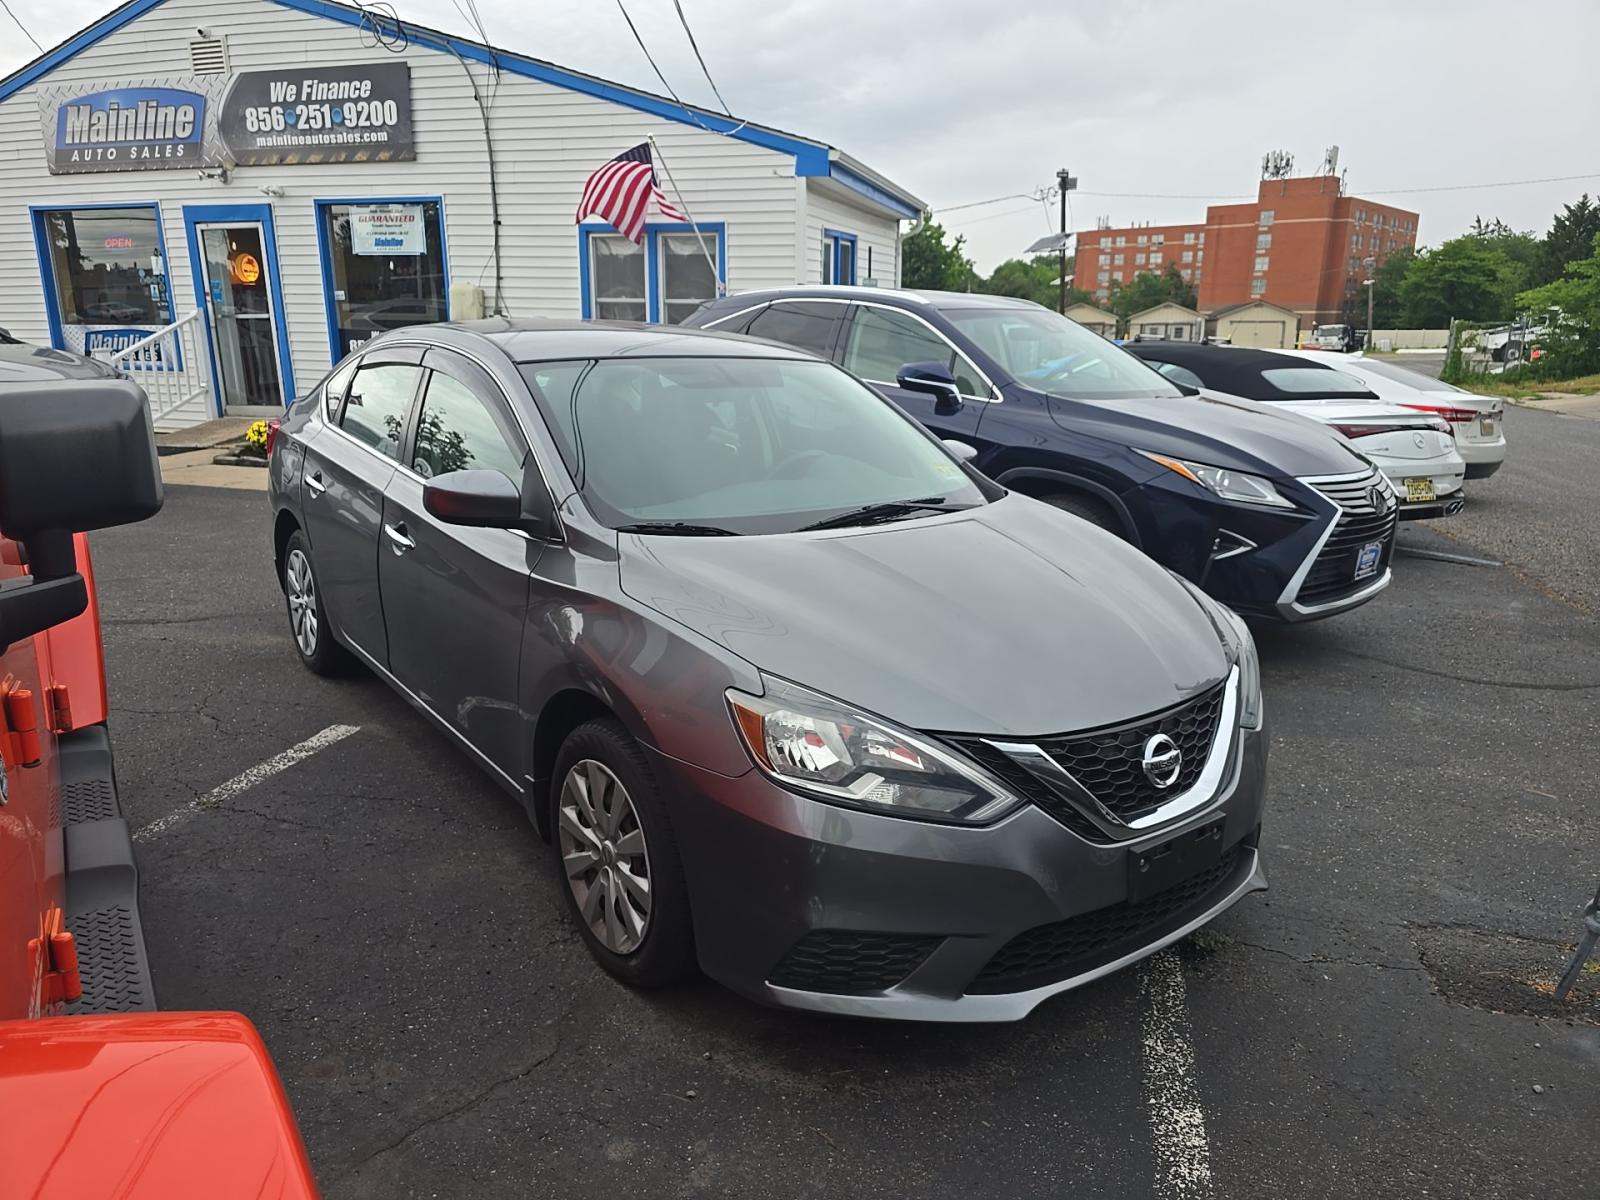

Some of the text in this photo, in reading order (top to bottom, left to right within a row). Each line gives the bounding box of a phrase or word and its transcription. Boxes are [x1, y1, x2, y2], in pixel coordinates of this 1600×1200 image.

[270, 79, 372, 103] We Finance
[65, 100, 195, 144] Mainline
[256, 131, 388, 147] mainlineautosales.com
[71, 144, 184, 162] AUTO SALES
[359, 215, 415, 223] GUARANTEED
[104, 238, 132, 248] OPEN
